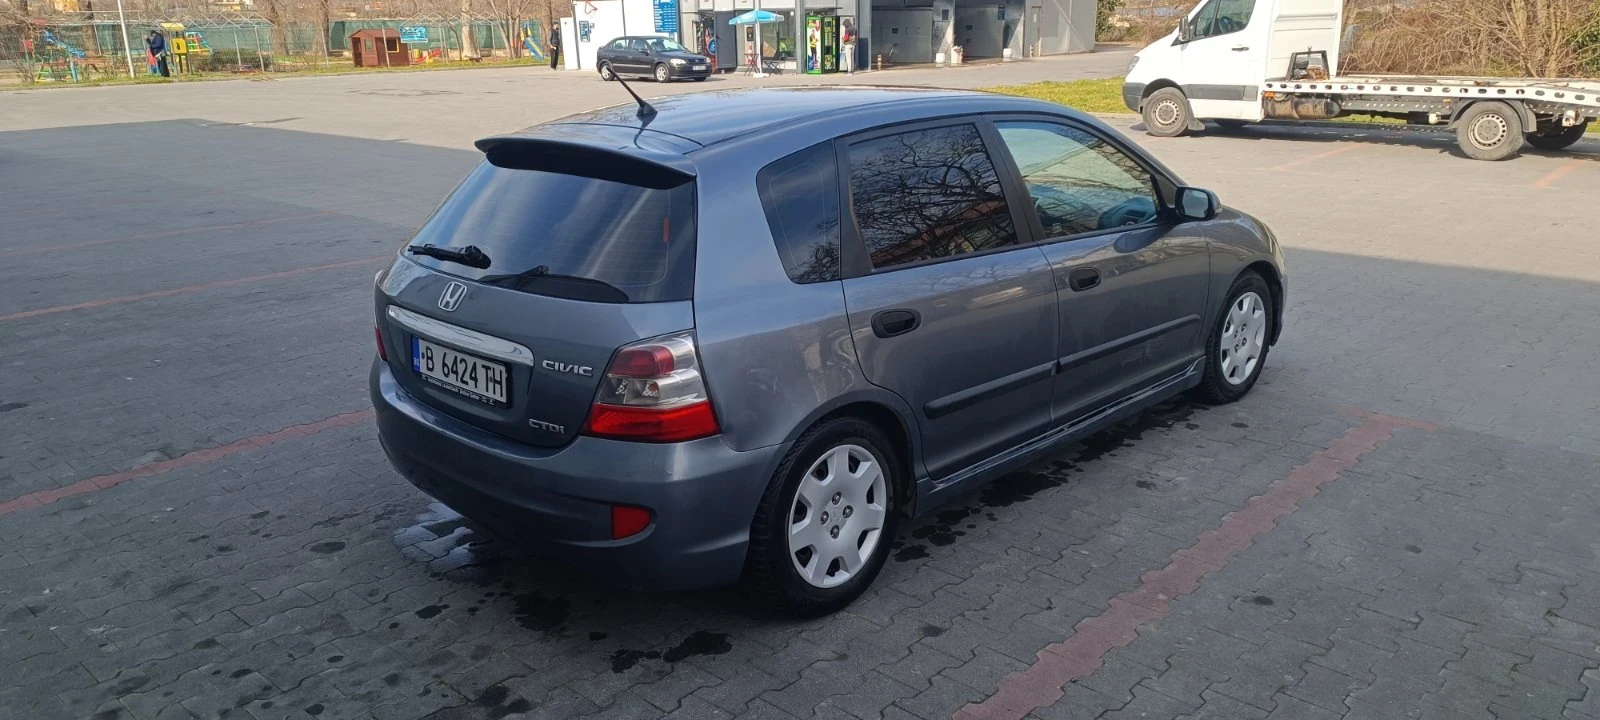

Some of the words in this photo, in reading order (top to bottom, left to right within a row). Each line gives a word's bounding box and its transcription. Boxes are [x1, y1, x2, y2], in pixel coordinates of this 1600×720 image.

[426, 346, 434, 372] B
[442, 352, 478, 388] 6424
[481, 364, 504, 397] TH
[542, 359, 593, 376] CIVIC
